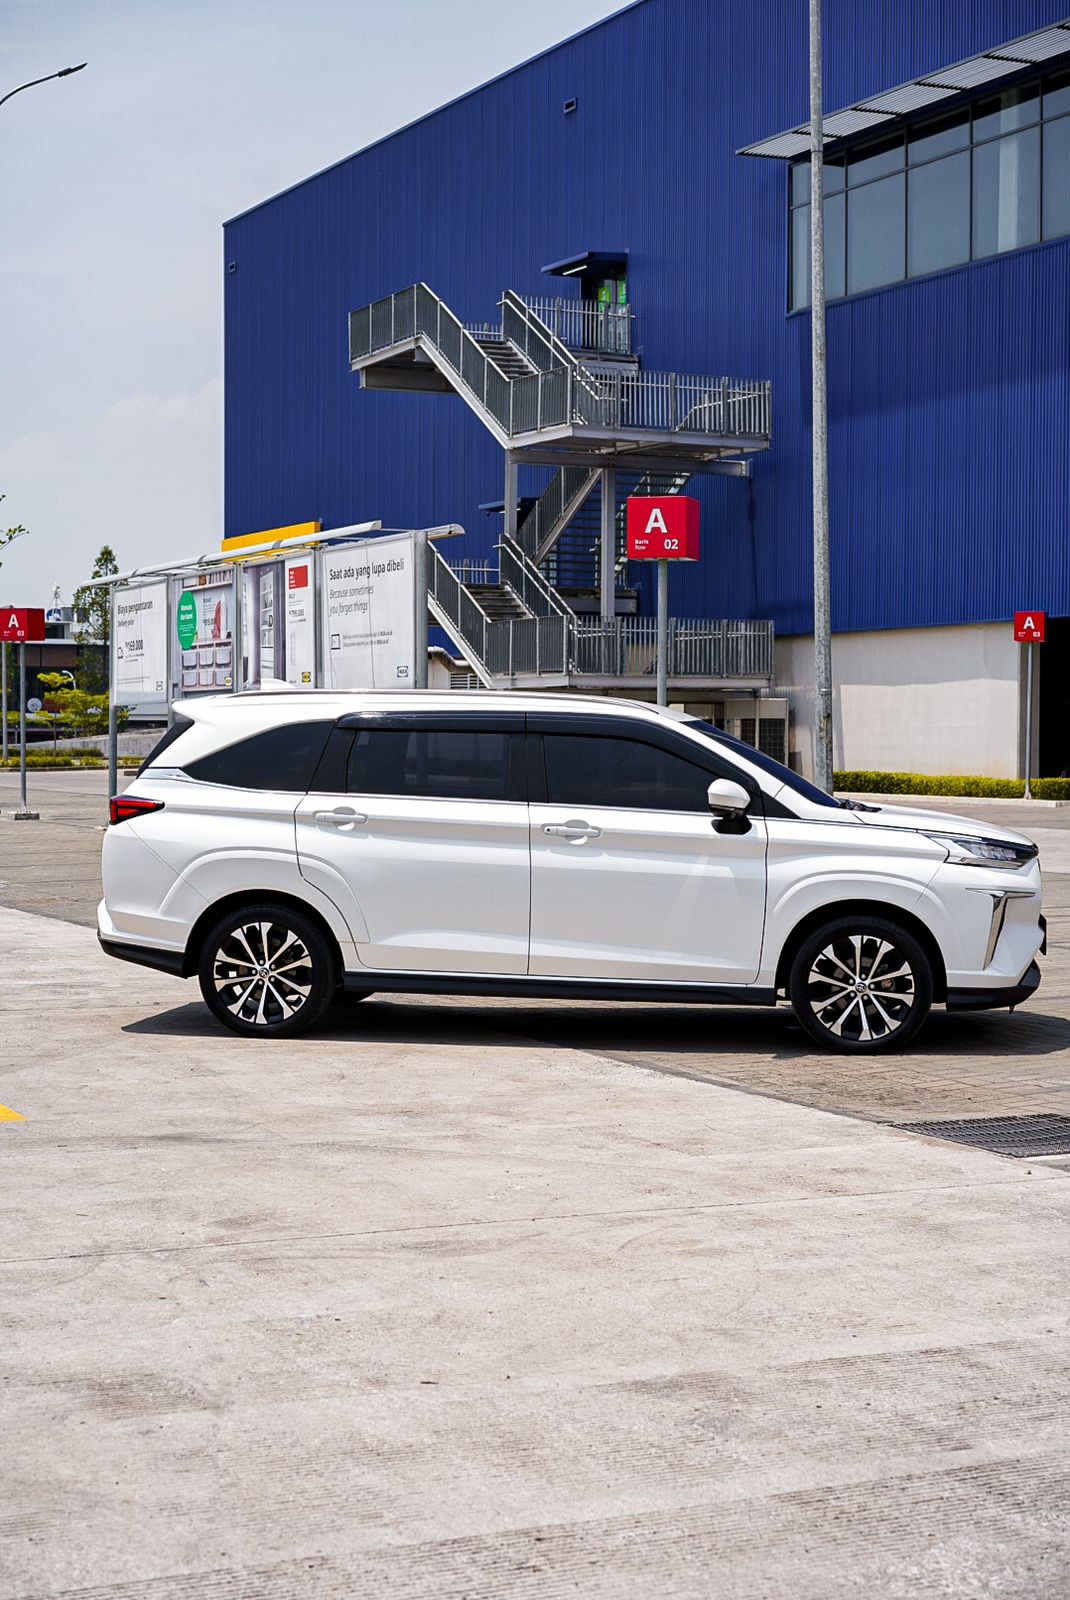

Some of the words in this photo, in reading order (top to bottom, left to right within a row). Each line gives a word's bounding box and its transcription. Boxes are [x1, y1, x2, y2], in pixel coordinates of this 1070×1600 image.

[644, 508, 668, 533] A
[664, 538, 679, 550] 02
[329, 568, 342, 580] Saat
[343, 566, 354, 578] ada
[355, 564, 371, 580] yang
[372, 561, 386, 576] lupa
[386, 558, 405, 572] dibeli
[8, 614, 19, 628] A
[1024, 616, 1035, 630] A
